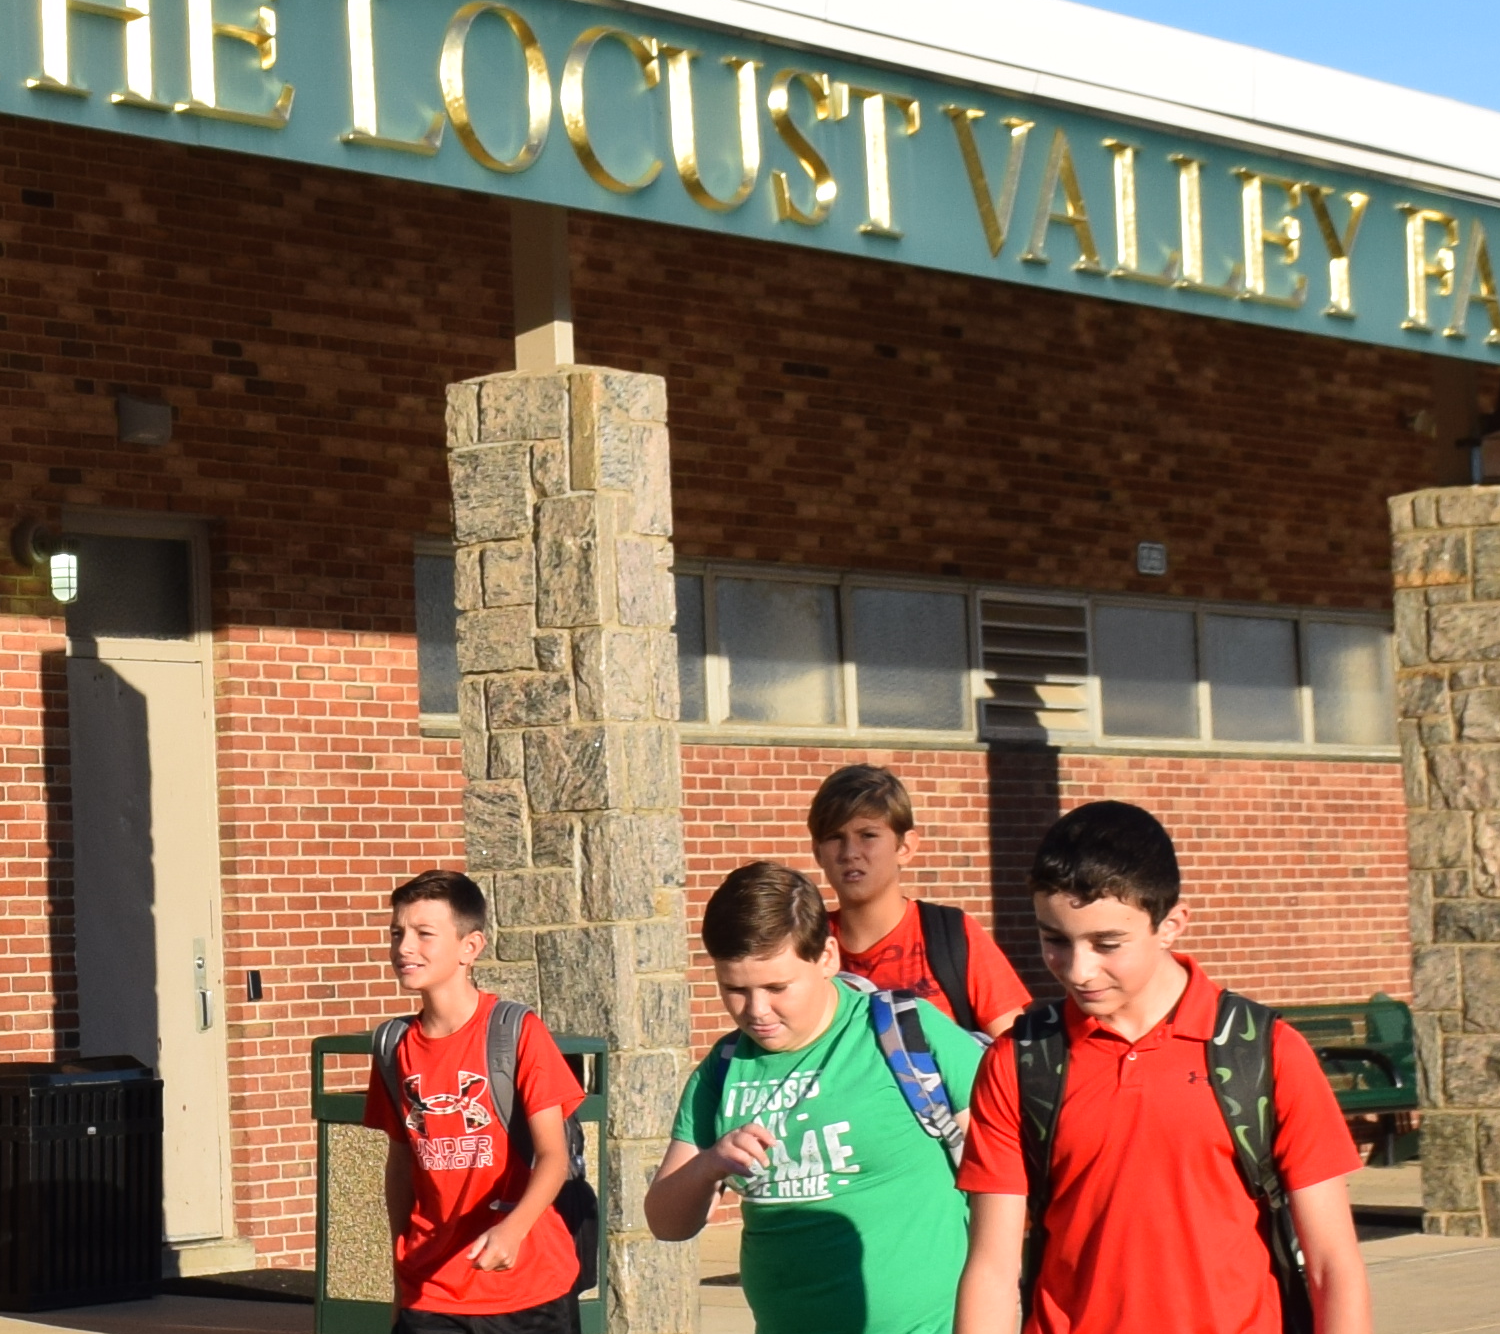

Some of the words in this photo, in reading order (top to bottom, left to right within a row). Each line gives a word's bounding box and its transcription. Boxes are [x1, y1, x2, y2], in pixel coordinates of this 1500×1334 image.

[938, 102, 1370, 320] VALLEY
[724, 1088, 737, 1118] I
[421, 1153, 494, 1171] RMOUR
